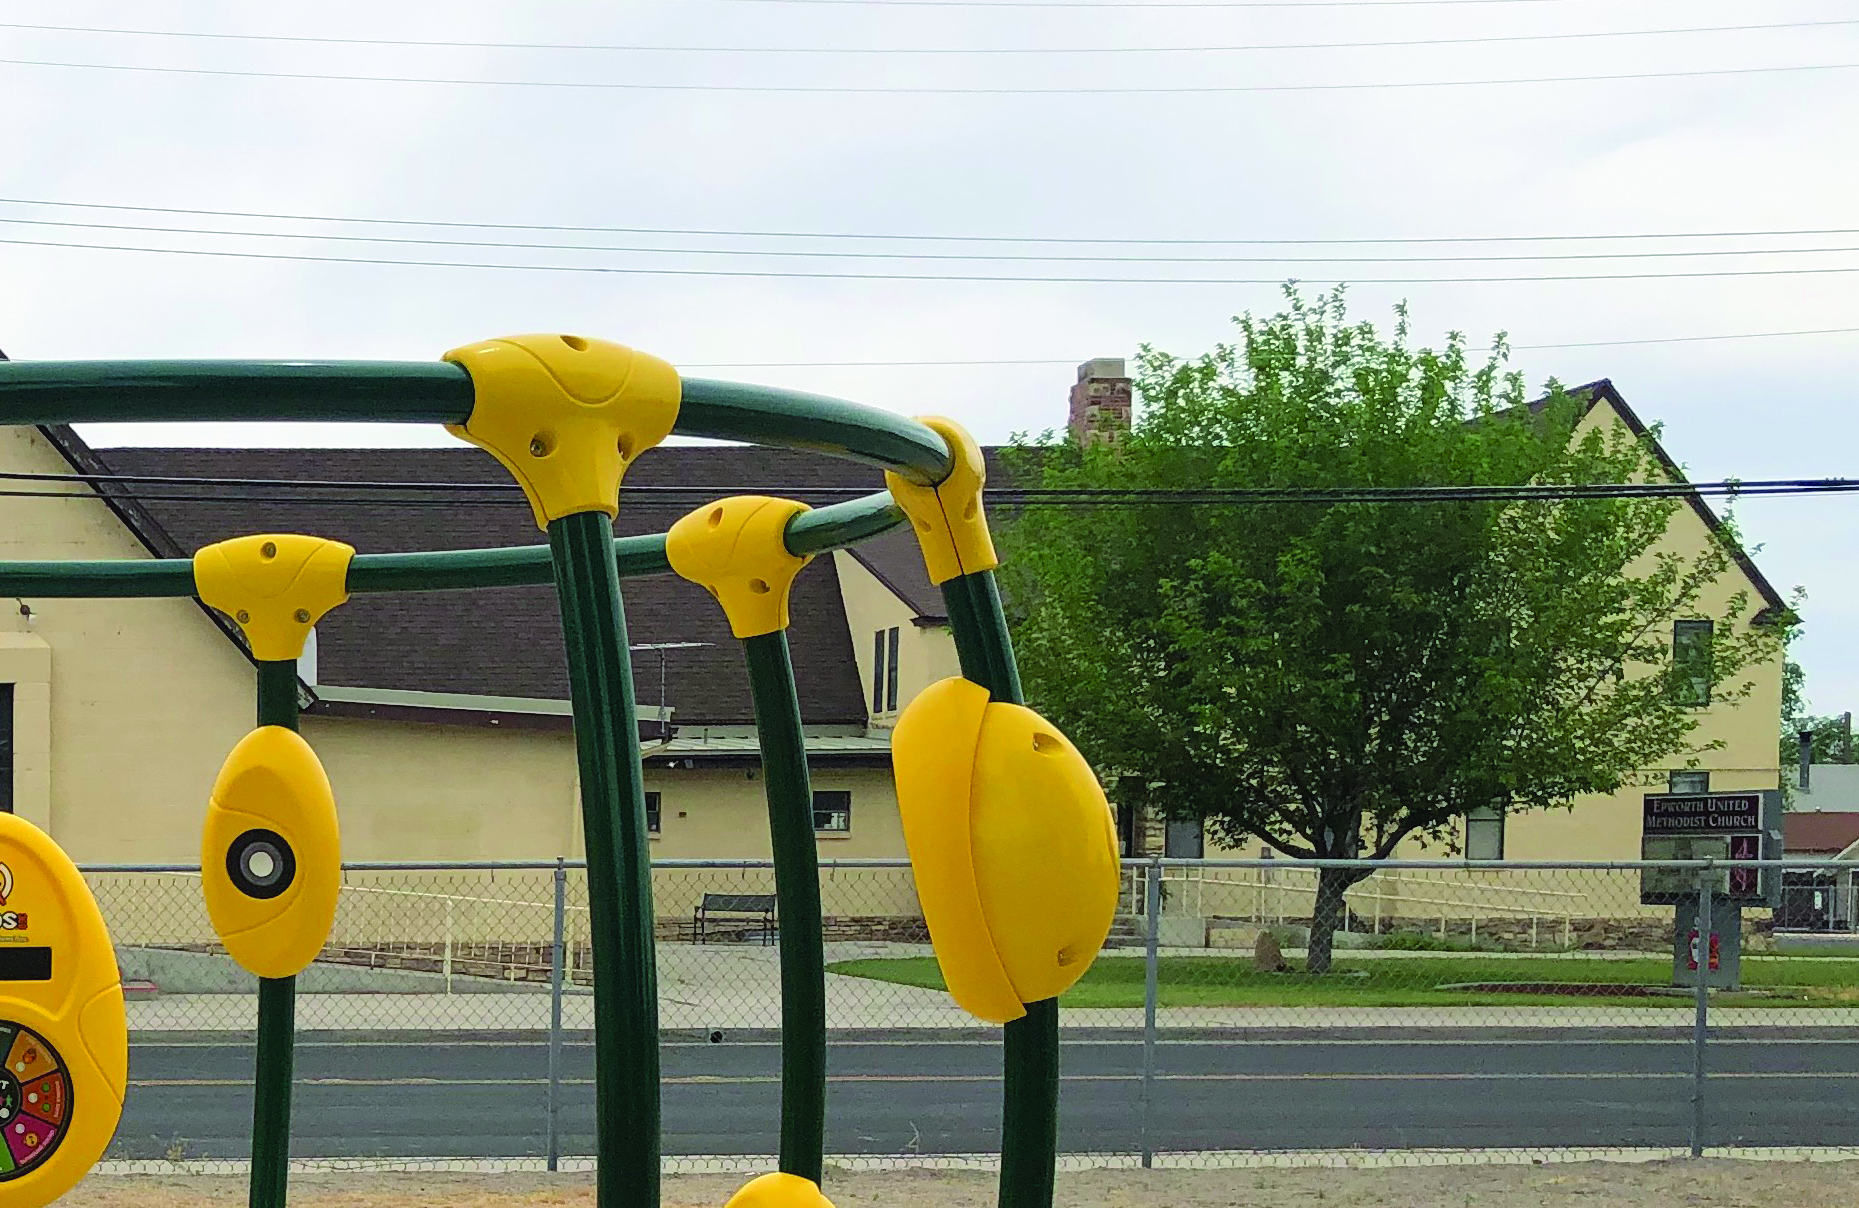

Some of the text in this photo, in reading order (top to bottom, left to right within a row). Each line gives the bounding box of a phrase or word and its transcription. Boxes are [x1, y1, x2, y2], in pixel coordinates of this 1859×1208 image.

[1653, 797, 1749, 813] EPWORTH UNITED
[1645, 813, 1756, 828] METHODIST CHURCH
